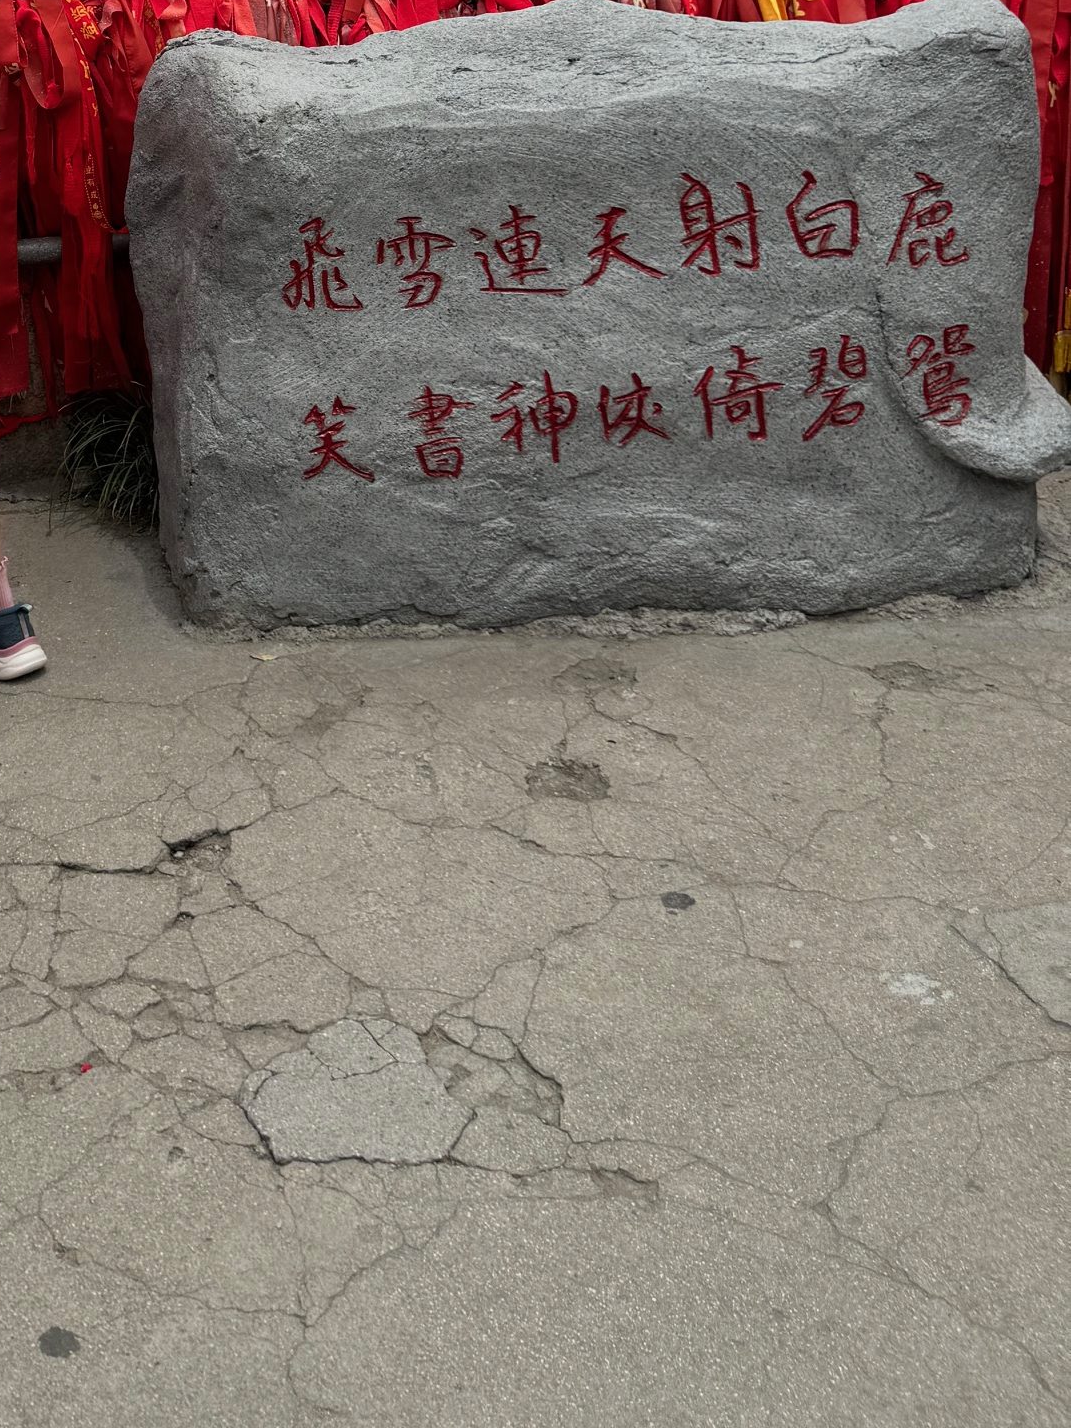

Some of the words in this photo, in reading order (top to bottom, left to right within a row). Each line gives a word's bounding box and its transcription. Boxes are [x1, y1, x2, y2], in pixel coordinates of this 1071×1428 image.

[281, 169, 971, 313] 飛雪連天射白鹿
